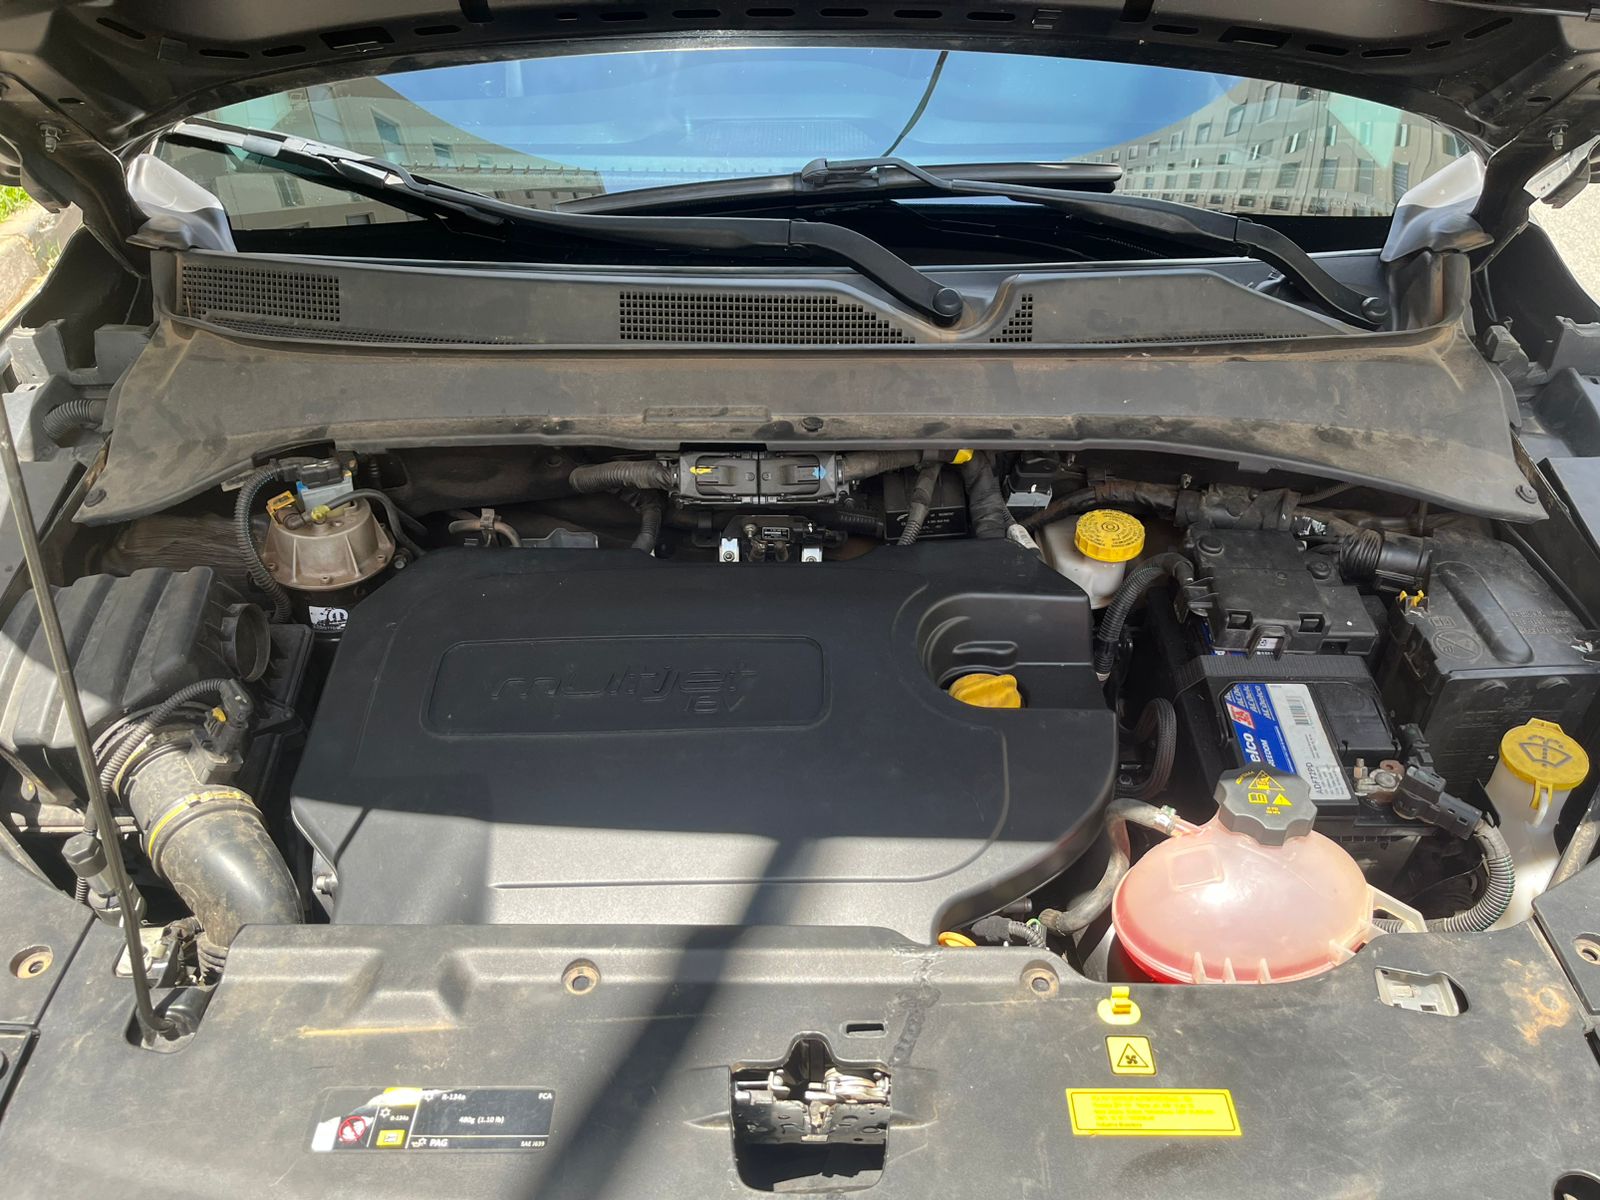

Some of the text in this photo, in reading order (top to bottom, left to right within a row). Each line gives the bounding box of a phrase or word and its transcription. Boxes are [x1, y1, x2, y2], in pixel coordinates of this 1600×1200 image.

[1243, 732, 1261, 762] elco
[538, 1092, 553, 1100] FCA
[429, 1138, 449, 1147] PAG
